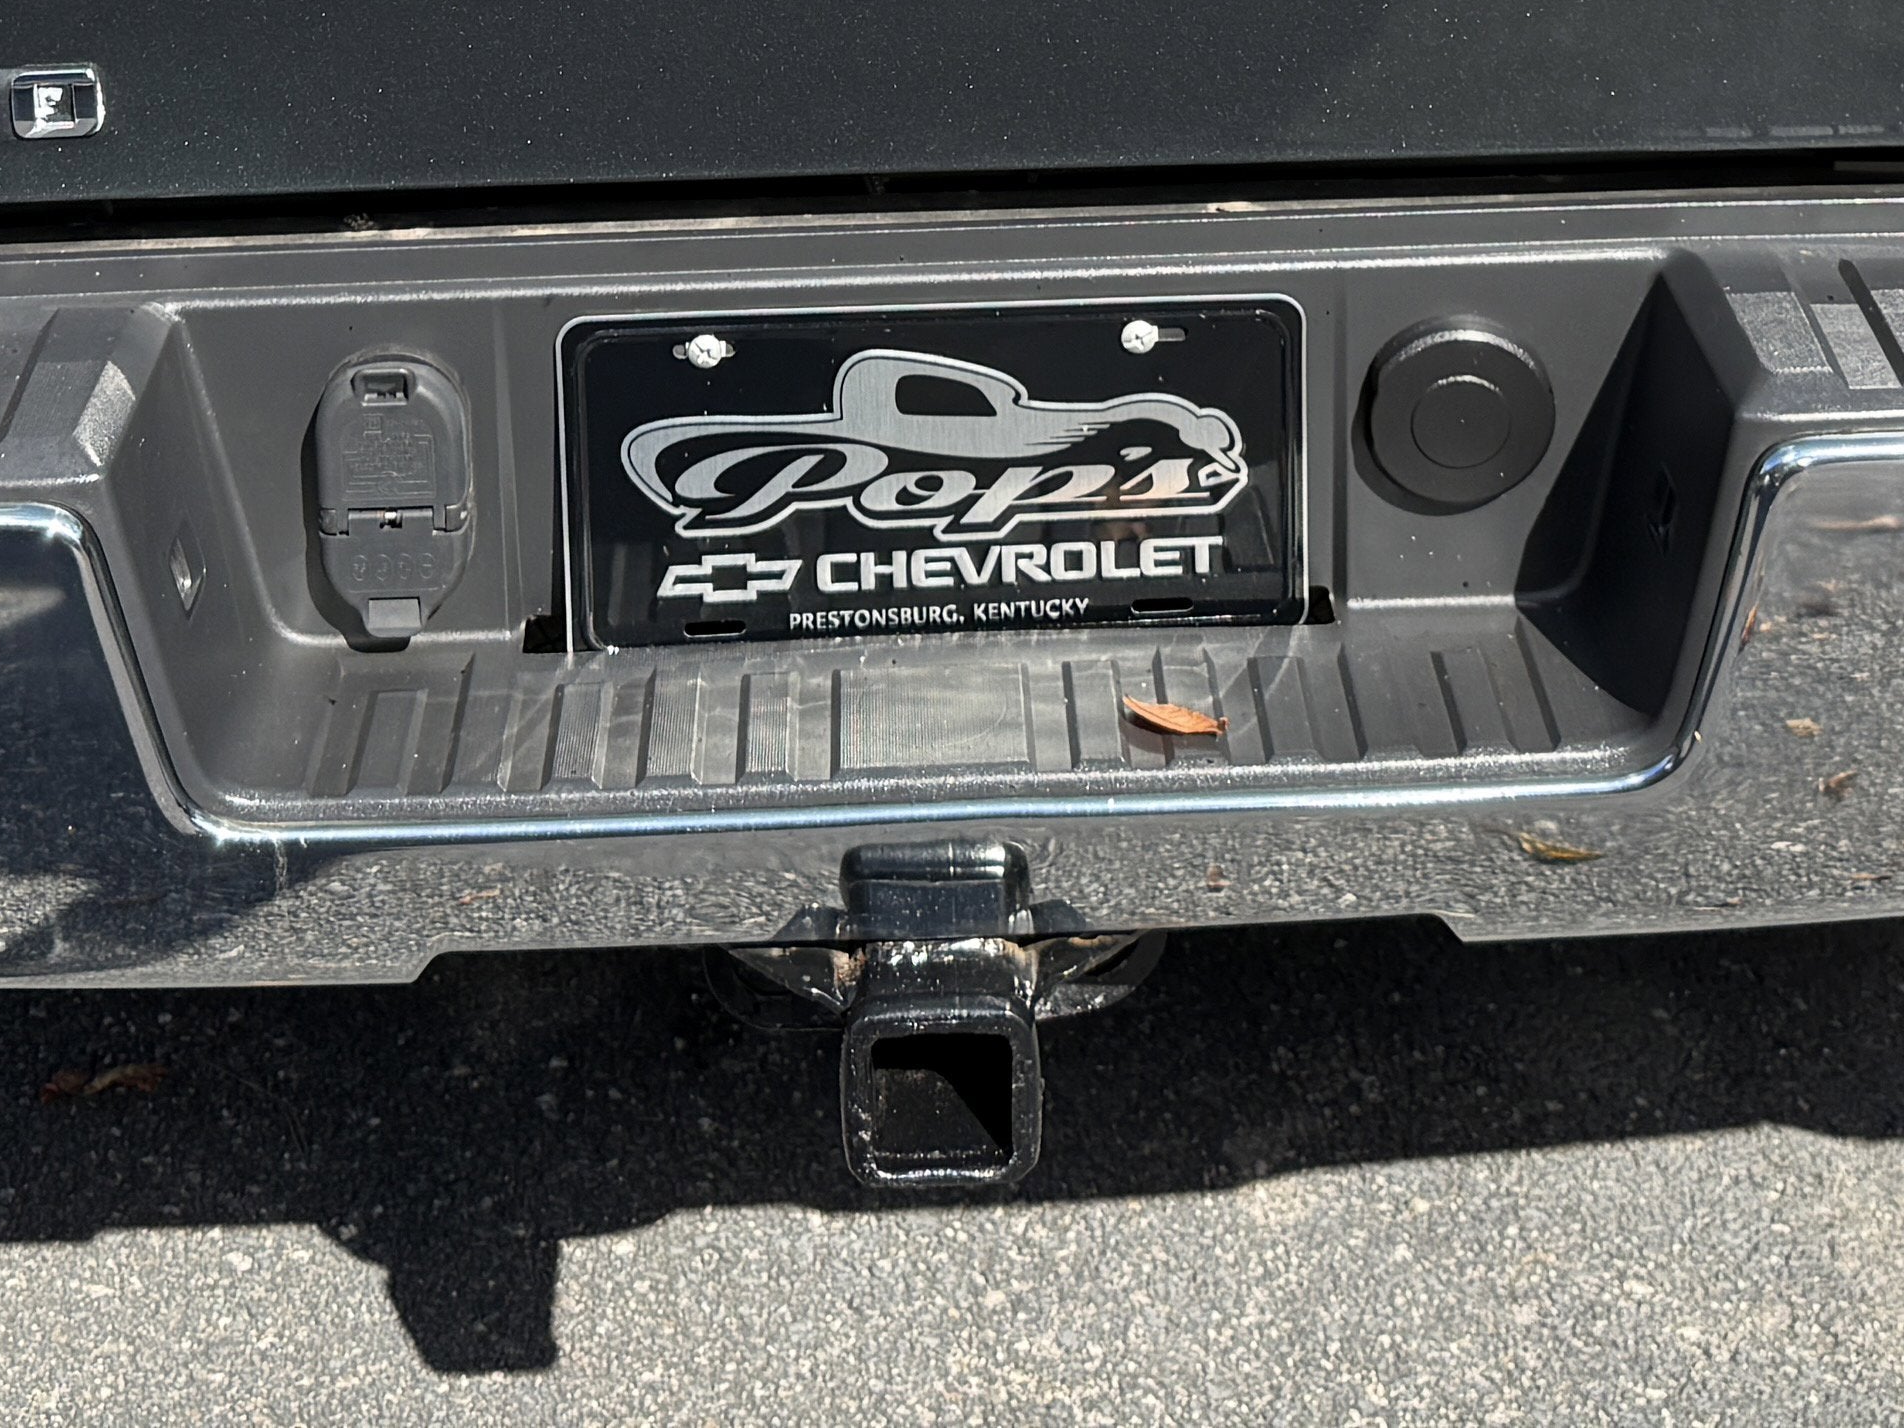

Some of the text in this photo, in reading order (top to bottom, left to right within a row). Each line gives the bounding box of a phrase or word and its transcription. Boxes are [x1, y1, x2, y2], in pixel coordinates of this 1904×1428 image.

[815, 535, 1224, 593] CHEVROLET
[788, 597, 1090, 632] PRESTONSBURG, KENTUCKY
